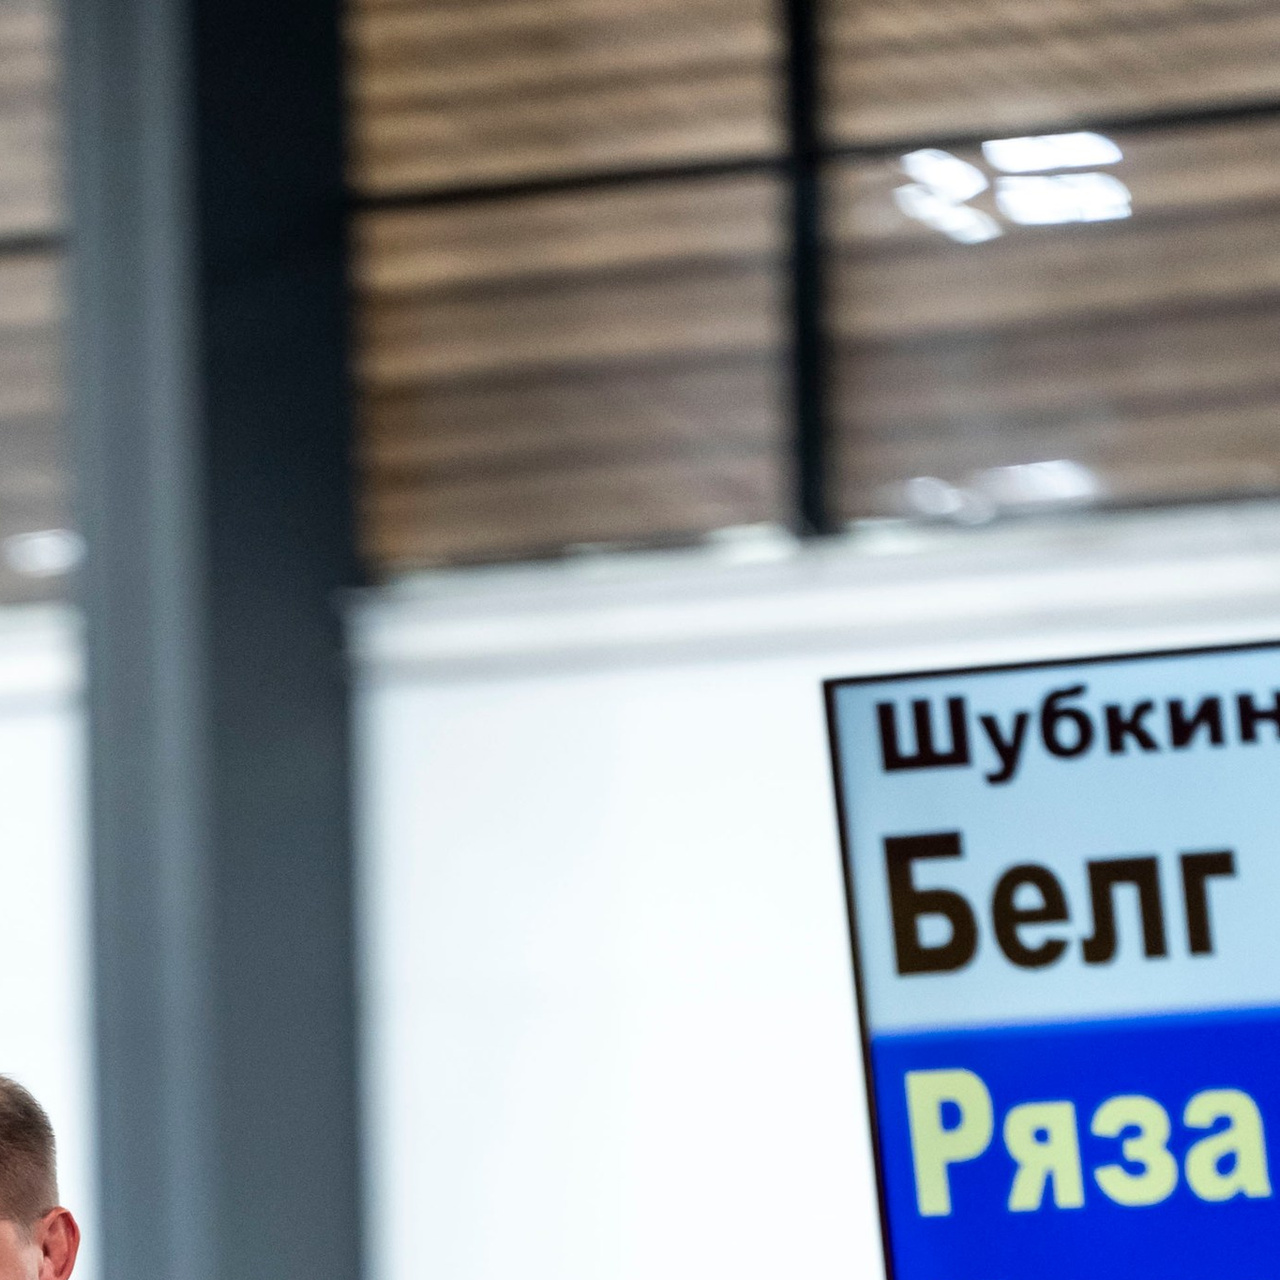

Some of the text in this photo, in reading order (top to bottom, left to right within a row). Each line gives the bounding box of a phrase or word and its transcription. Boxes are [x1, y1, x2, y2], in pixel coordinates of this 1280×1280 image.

[877, 682, 1280, 785] Шубкин
[882, 831, 1237, 977] Белг
[904, 1068, 1272, 1217] Ряза
